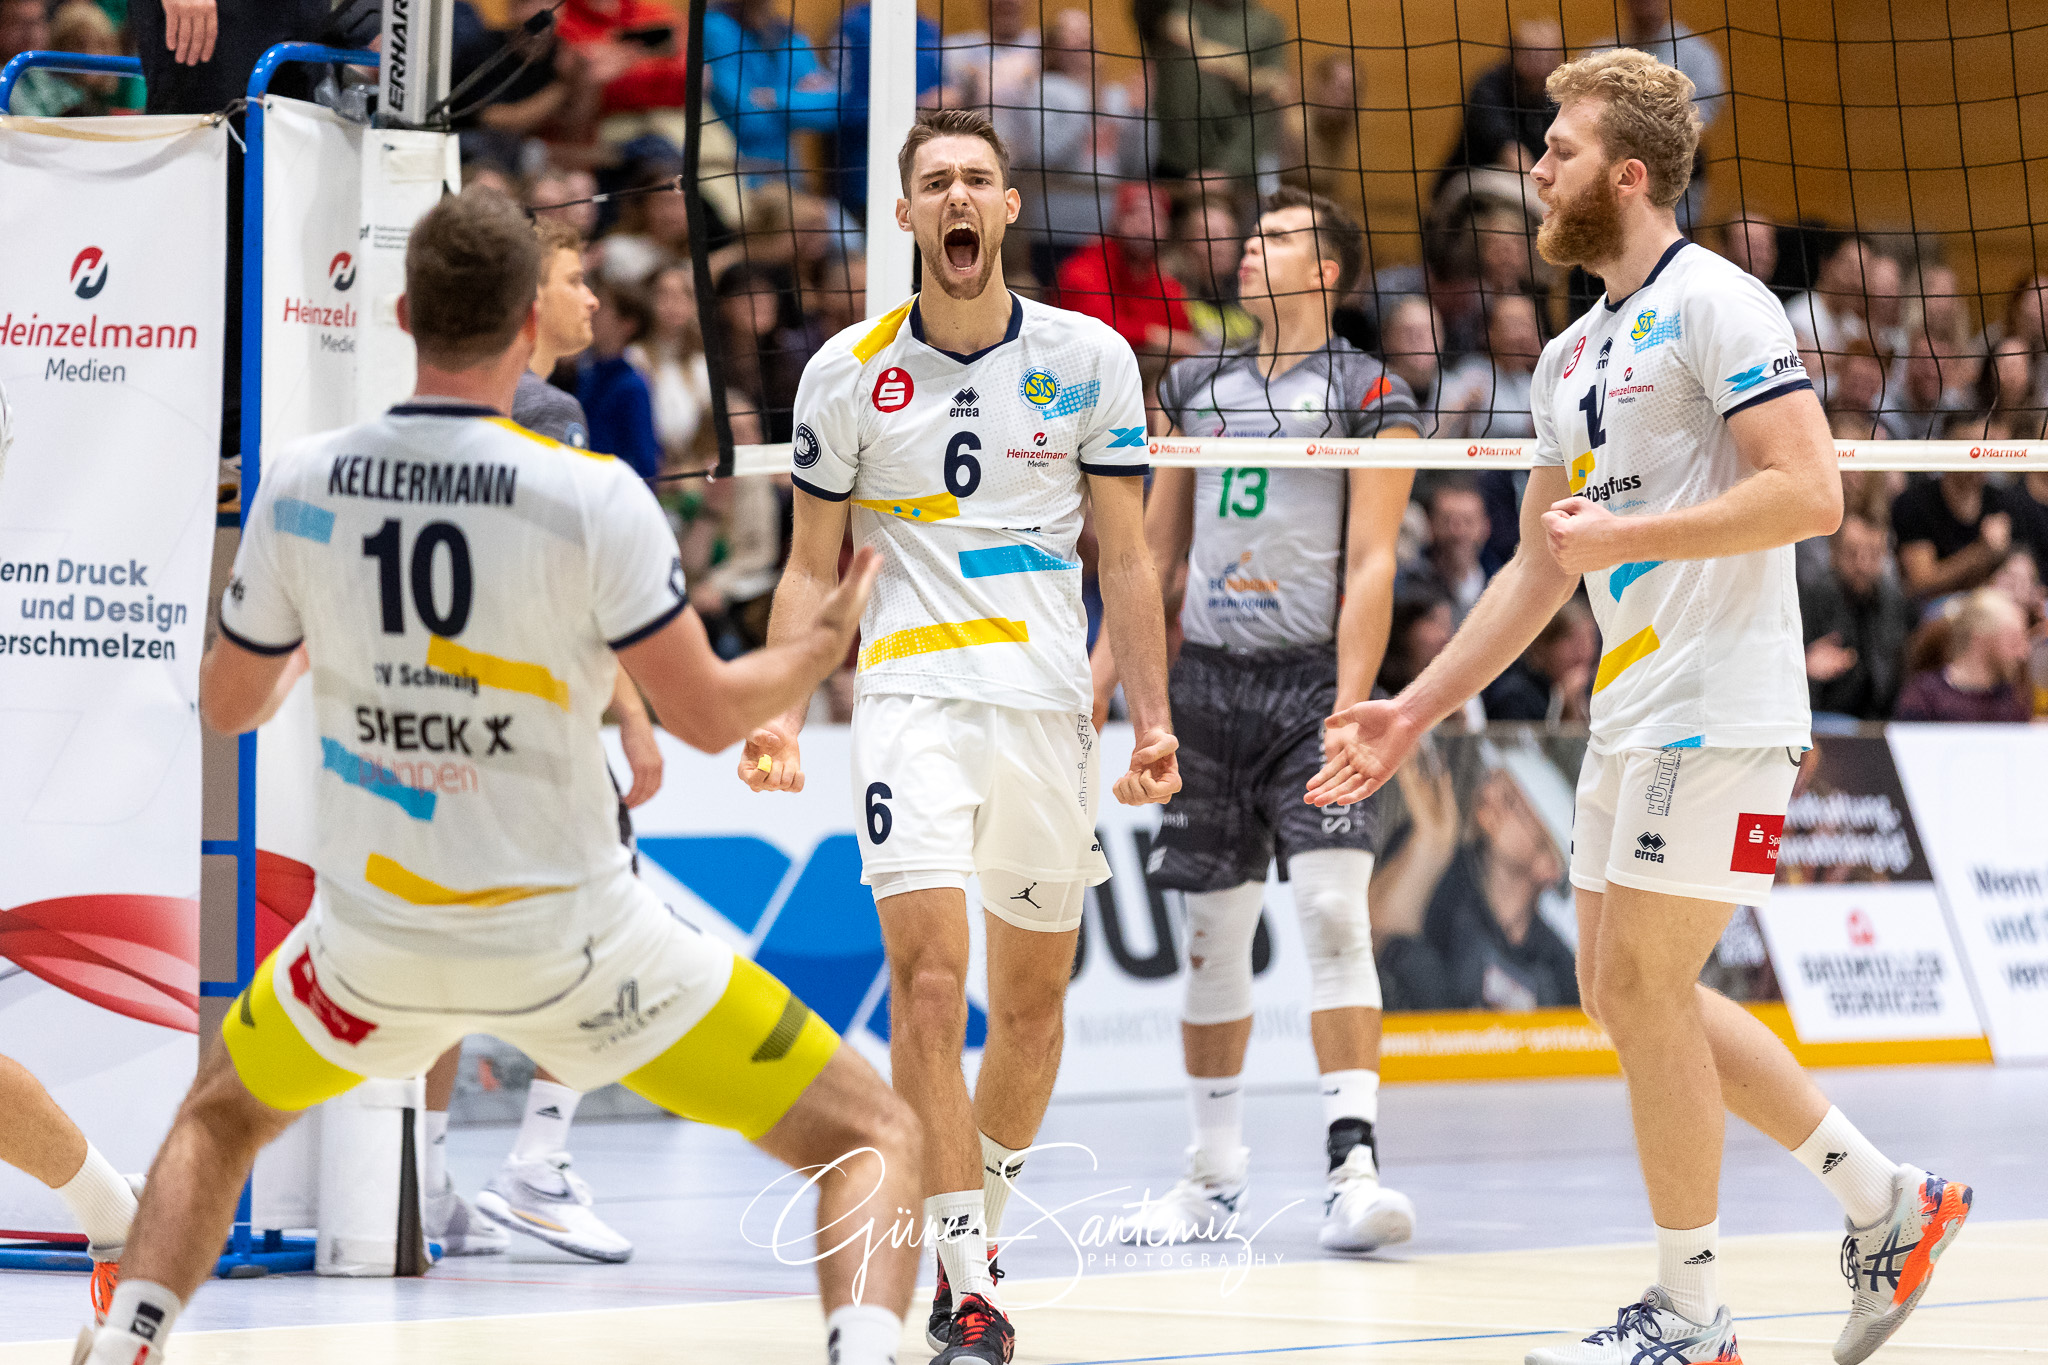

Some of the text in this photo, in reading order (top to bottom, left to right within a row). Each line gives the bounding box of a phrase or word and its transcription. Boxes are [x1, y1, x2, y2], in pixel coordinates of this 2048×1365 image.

[283, 297, 357, 327] Heinzel
[45, 358, 126, 382] Medien
[1608, 384, 1654, 399] Heinzelmann
[950, 407, 980, 418] errea
[1160, 445, 1201, 454] Marmot
[1317, 445, 1361, 456] Marmot
[1479, 445, 1523, 456] Marmot
[1982, 448, 2028, 458] Marmot
[943, 430, 982, 499] 6
[328, 455, 518, 507] KELLERMANN
[1218, 467, 1268, 518] 13
[0, 559, 149, 586] enn Druck
[362, 518, 473, 638] 10
[21, 594, 188, 633] und Design
[400, 663, 479, 697] Schwaig
[865, 782, 893, 845] 6
[1634, 848, 1665, 863] errea
[1821, 1151, 1848, 1175] adidas
[1684, 1254, 1716, 1265] adidas
